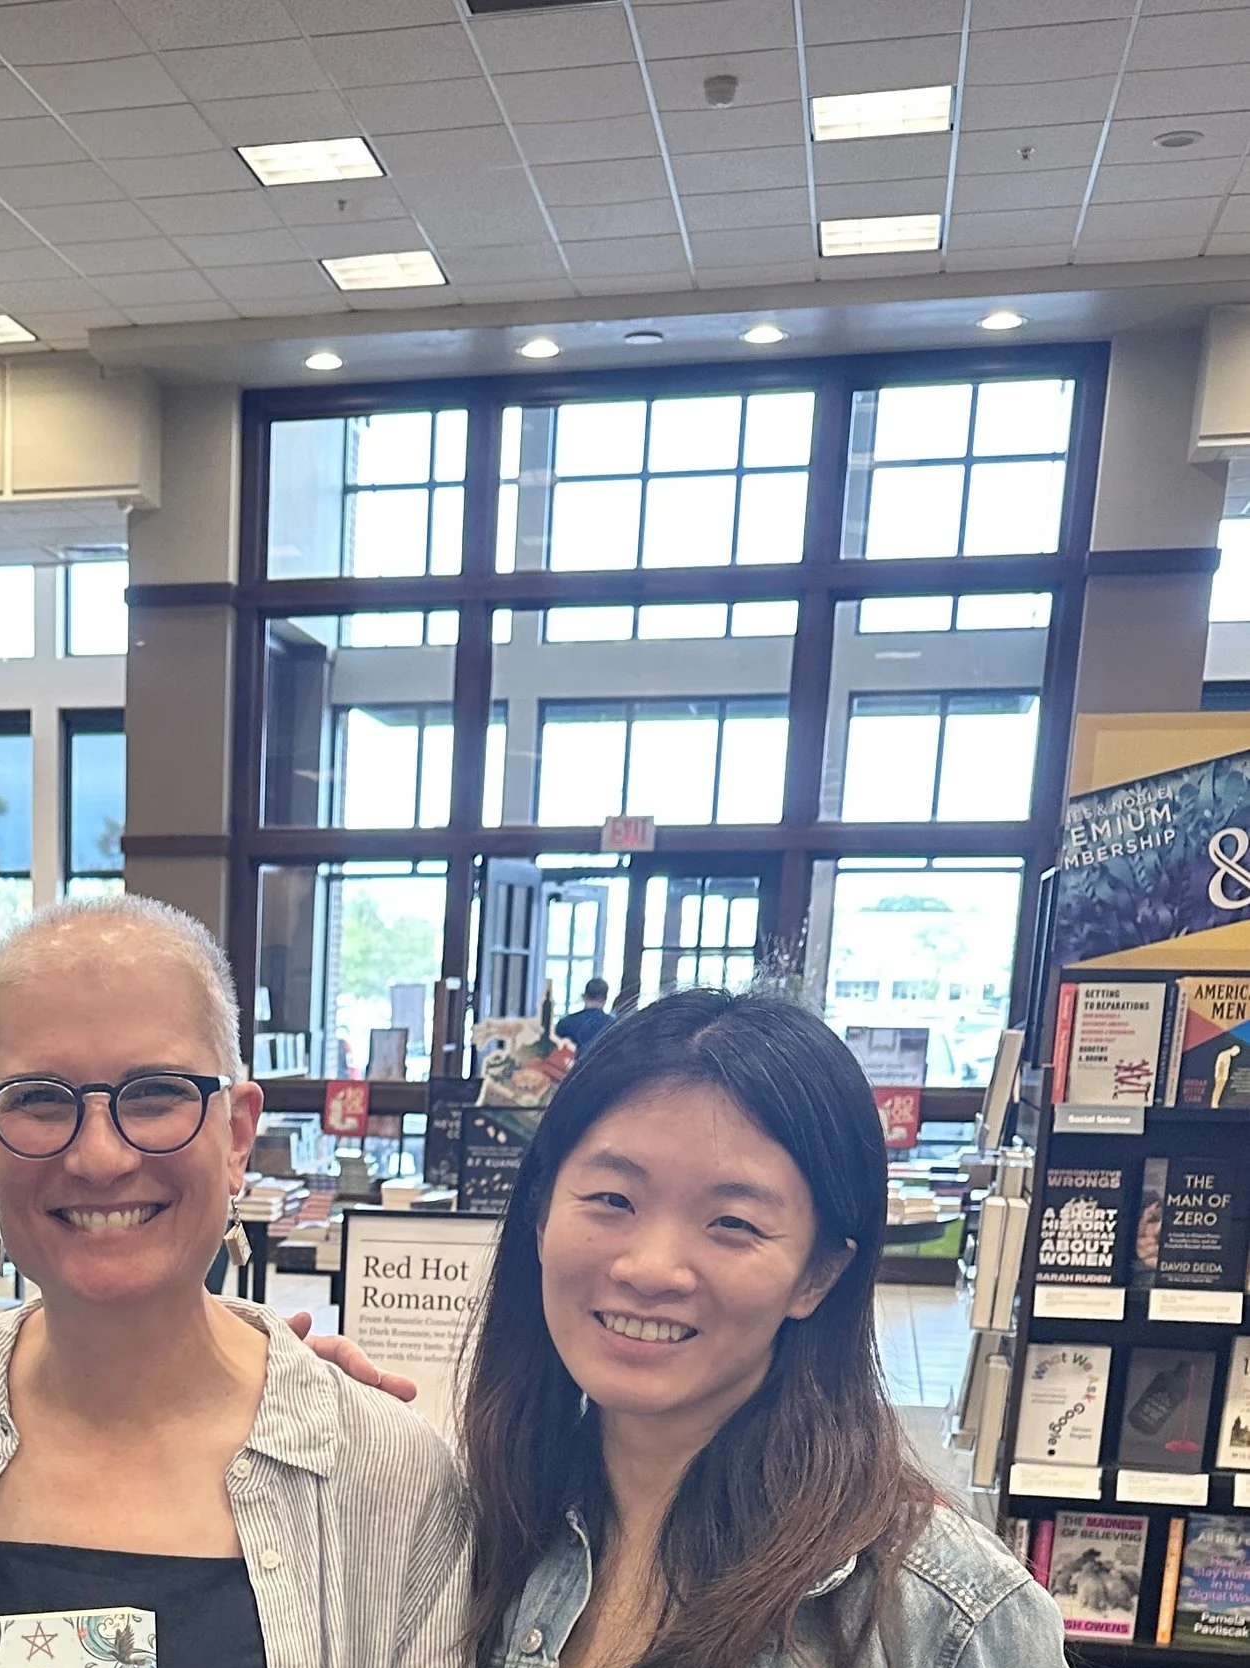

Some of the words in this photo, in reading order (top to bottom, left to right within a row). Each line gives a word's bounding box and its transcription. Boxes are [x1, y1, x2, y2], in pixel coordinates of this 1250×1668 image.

[1070, 803, 1172, 848] EMIUM
[1064, 828, 1176, 870] MBERSHIP
[1084, 988, 1120, 999] GETTING
[1194, 983, 1250, 1000] AMERIC
[1084, 1001, 1095, 1011] TO
[1096, 1001, 1150, 1011] REPARATIONS
[1211, 1002, 1247, 1020] MEN
[1068, 1114, 1095, 1124] Social
[1096, 1114, 1132, 1125] Science
[1047, 1176, 1122, 1189] WRONGS
[1184, 1174, 1215, 1190] THE
[1166, 1193, 1204, 1208] MAN
[1207, 1193, 1232, 1209] OF
[1044, 1207, 1056, 1219] A
[1059, 1206, 1118, 1221] SHORT
[1172, 1210, 1218, 1227] ZERO
[1041, 1219, 1117, 1232] HISTORY
[1057, 1231, 1082, 1240] BAD
[1039, 1239, 1114, 1254] ABOUT
[1038, 1252, 1113, 1267] WOMEN
[362, 1255, 411, 1279] Red
[420, 1257, 469, 1282] Hot
[1160, 1261, 1191, 1273] DAVID
[1192, 1262, 1223, 1274] DEIDA
[1035, 1272, 1074, 1282] SARAH
[1074, 1273, 1112, 1284] RUDEN
[361, 1285, 479, 1313] Romance
[369, 1327, 389, 1336] Dark
[1047, 1402, 1086, 1446] Google
[1063, 1515, 1083, 1525] THE
[1085, 1516, 1144, 1531] MADNESS
[1061, 1527, 1080, 1538] OF
[1080, 1528, 1142, 1542] BELIEVING
[1198, 1531, 1214, 1542] All
[1215, 1532, 1235, 1546] the
[1193, 1565, 1220, 1580] Stay
[1211, 1579, 1223, 1589] in
[1225, 1579, 1245, 1591] the
[1188, 1588, 1227, 1604] Digital
[1200, 1611, 1247, 1626] Pamela
[1084, 1621, 1129, 1634] OWENS
[1193, 1622, 1250, 1638] Pavliscak
